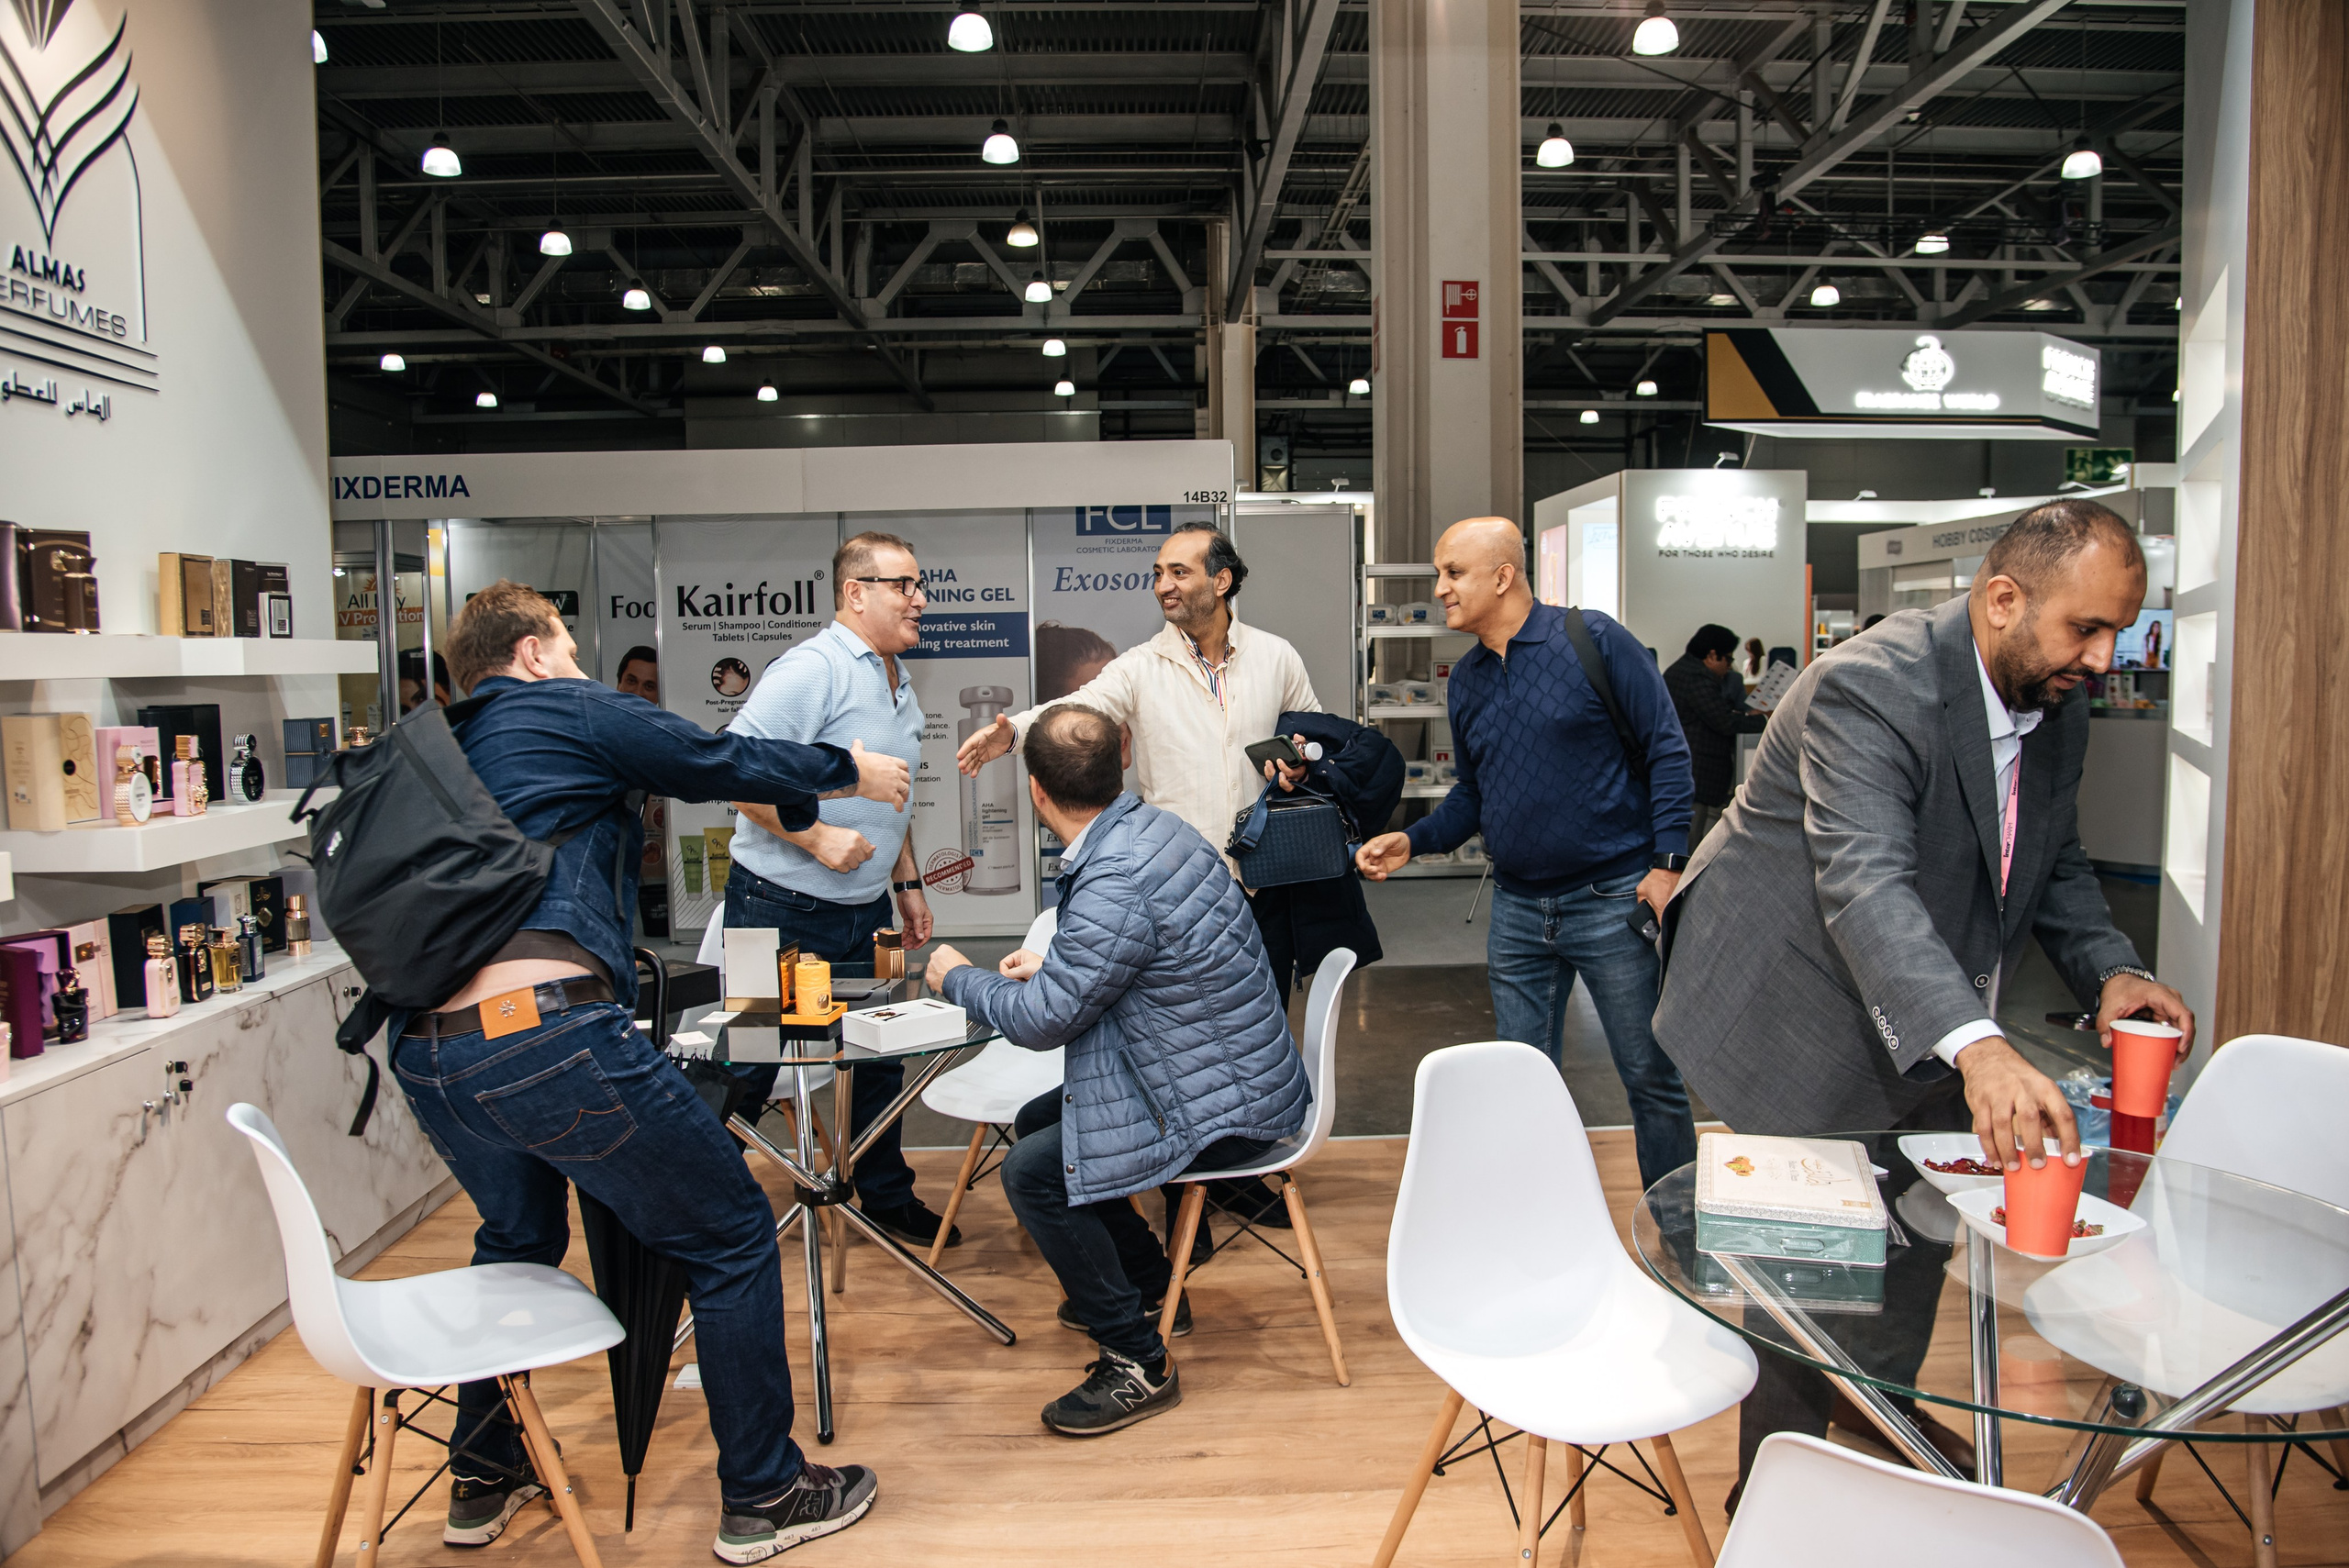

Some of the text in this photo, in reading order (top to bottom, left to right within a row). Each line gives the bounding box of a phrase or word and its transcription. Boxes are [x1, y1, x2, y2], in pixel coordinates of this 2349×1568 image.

[10, 244, 85, 293] ALMAS
[330, 474, 471, 500] IXDERMA
[1183, 491, 1228, 503] 14B32
[1085, 505, 1163, 531] FCL
[1932, 529, 1967, 549] HOBBY
[1076, 546, 1115, 554] COSMETIC
[1658, 550, 1774, 558] FOR THOSE WHO DESIRE
[348, 594, 369, 608] All
[981, 587, 1015, 601] GEL
[353, 609, 424, 625] Protion
[682, 619, 822, 631] Serum Shampoo Conditioner
[970, 620, 996, 631] skin
[712, 631, 793, 642] Tablets Capsules
[944, 638, 1009, 649] treatment
[925, 860, 973, 884] RECOMMENDED
